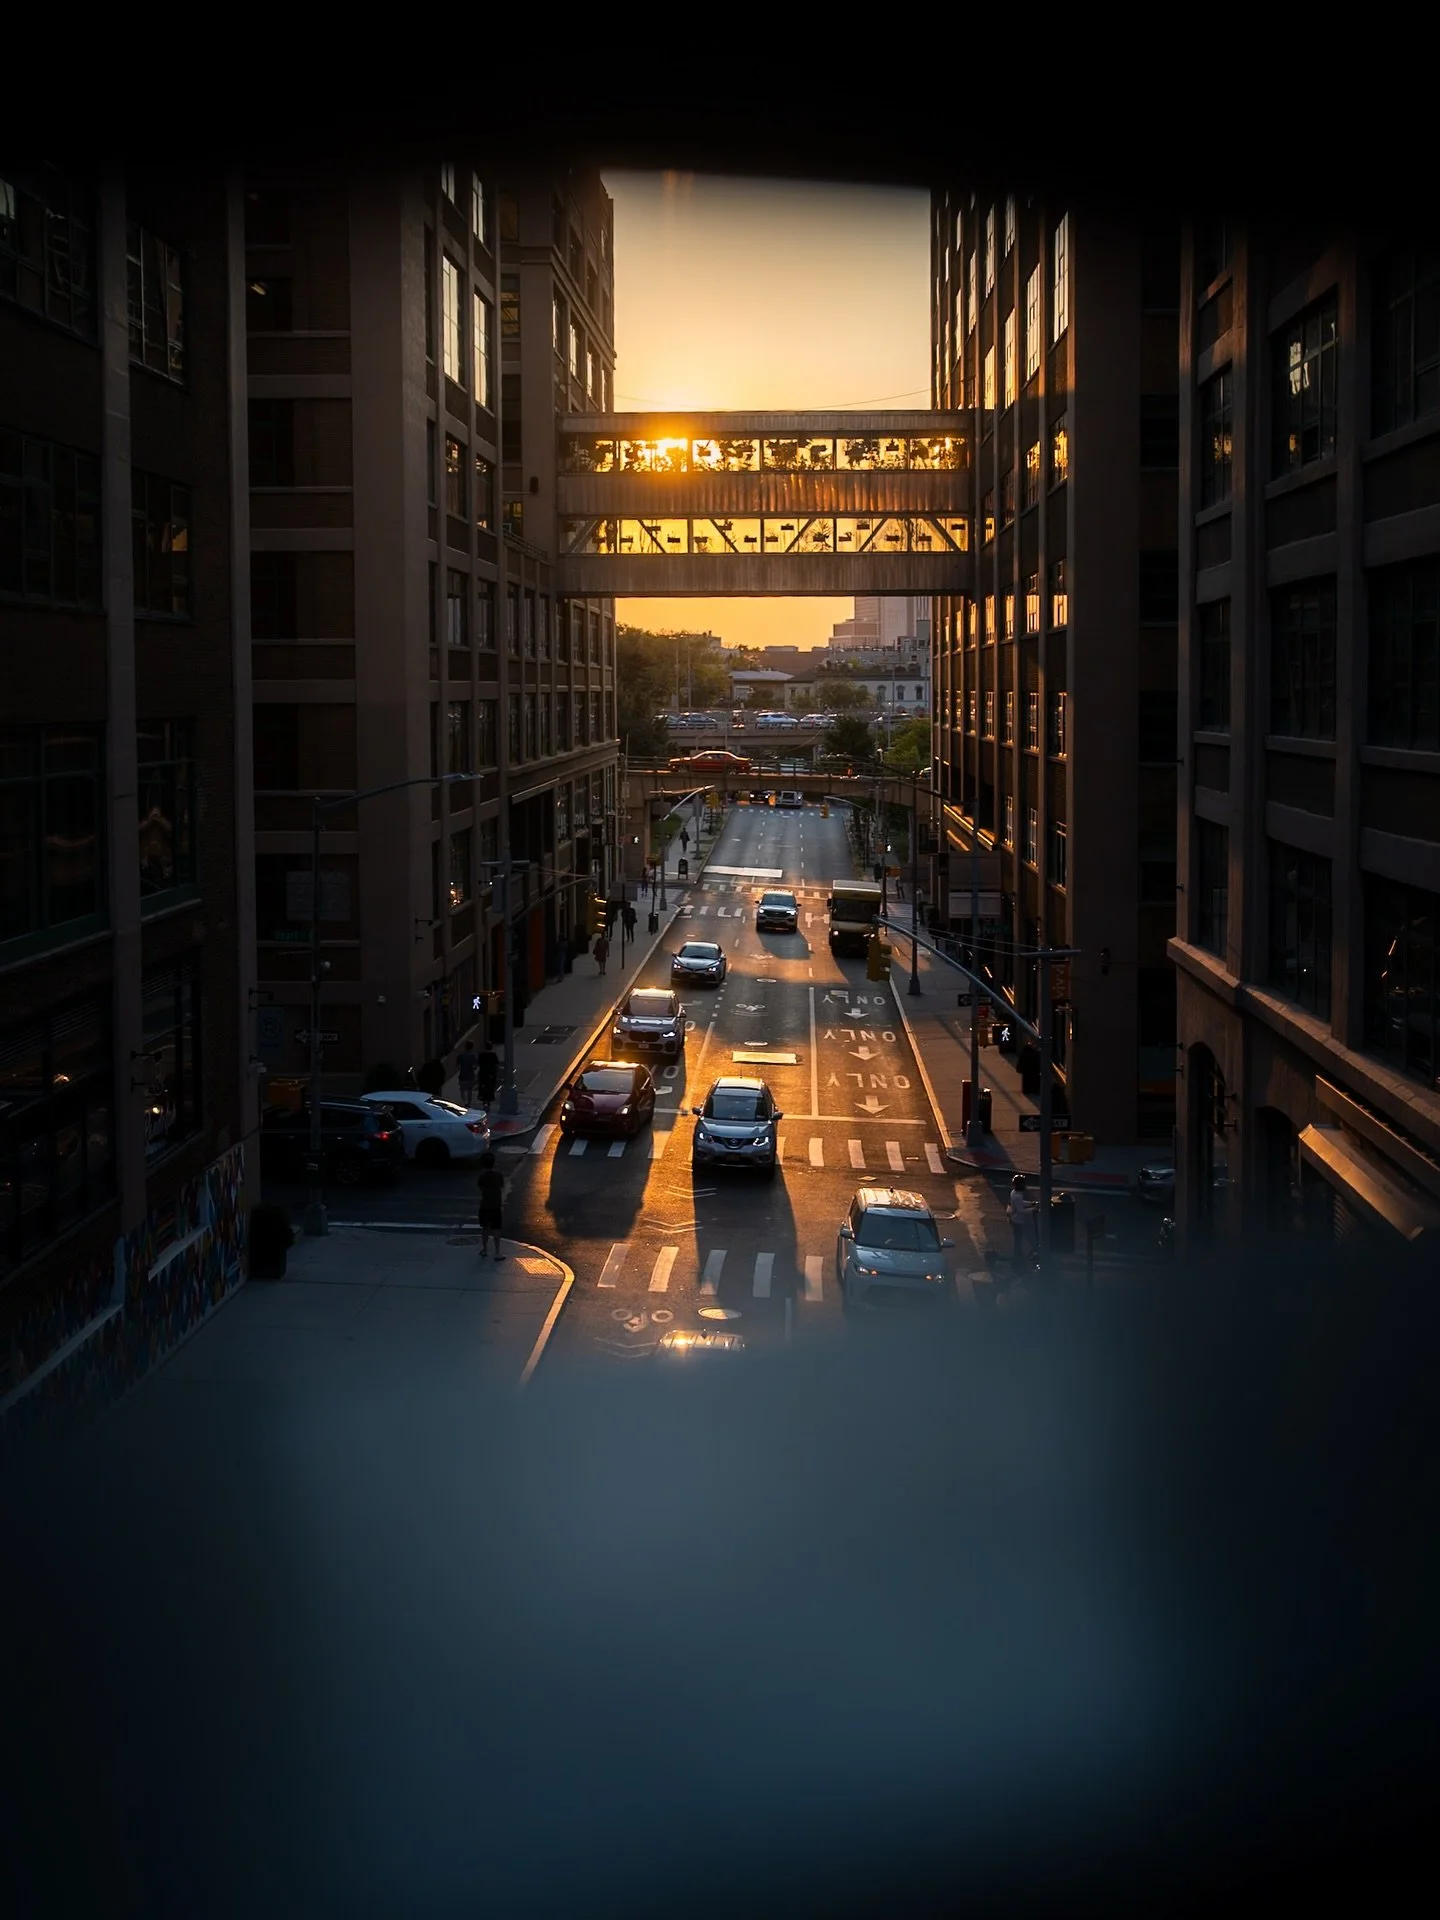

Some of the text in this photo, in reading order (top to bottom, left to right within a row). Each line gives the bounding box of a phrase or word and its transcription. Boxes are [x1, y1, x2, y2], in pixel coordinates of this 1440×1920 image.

[822, 994, 886, 1005] ONLY
[823, 1028, 897, 1043] ONLY
[826, 1071, 911, 1089] ONLY
